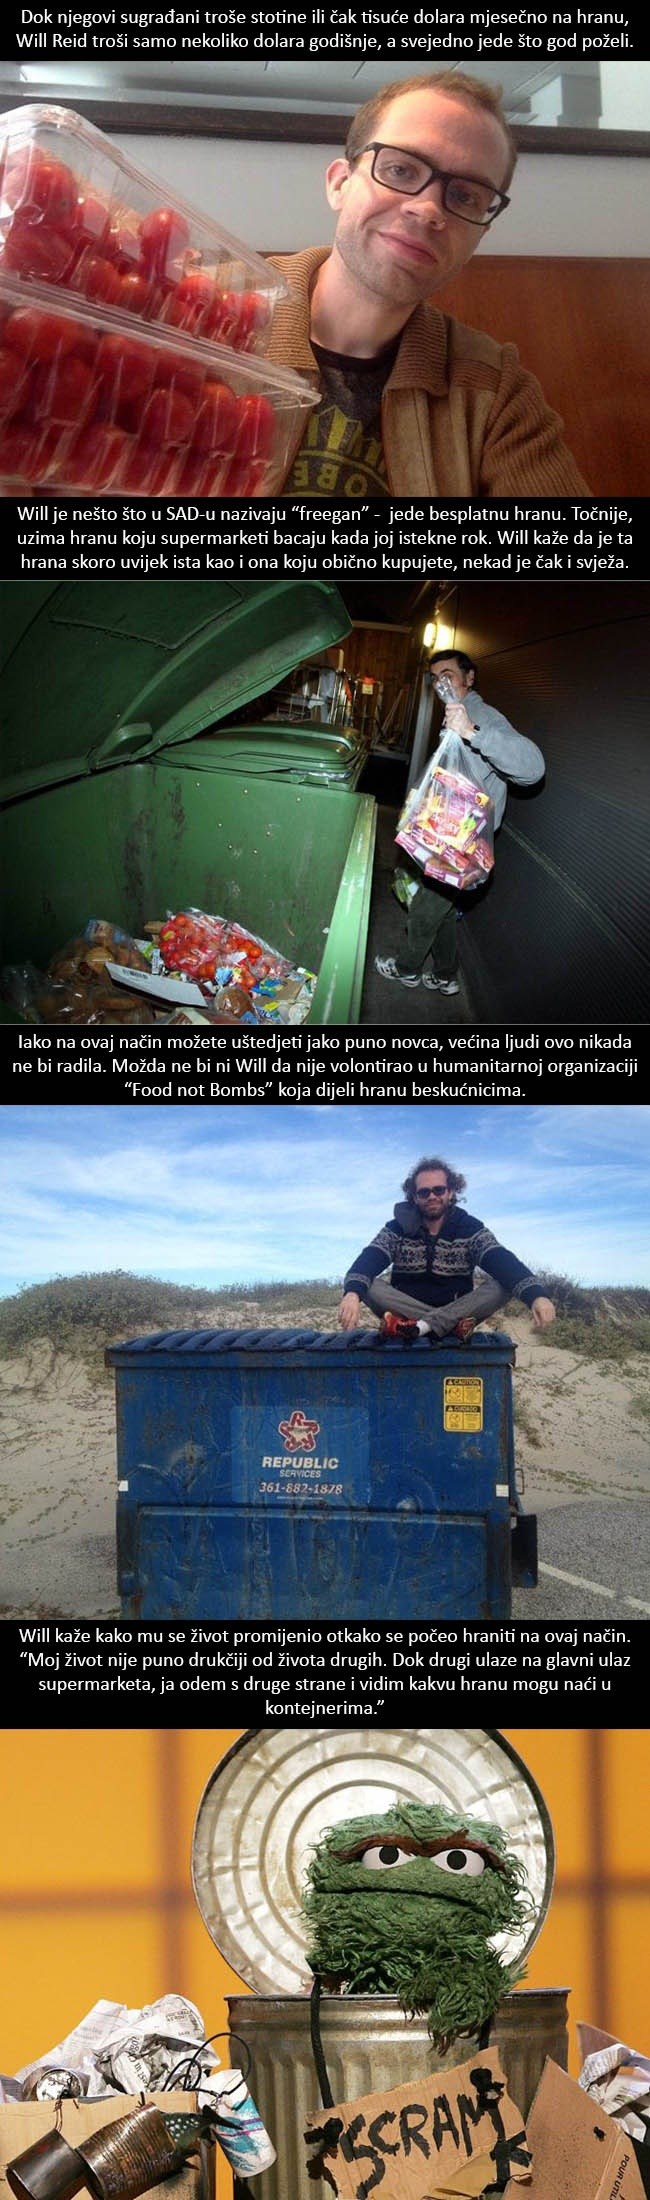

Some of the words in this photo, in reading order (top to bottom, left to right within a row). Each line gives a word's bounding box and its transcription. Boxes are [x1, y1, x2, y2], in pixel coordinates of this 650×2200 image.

[261, 1456, 340, 1470] REPUBLIC
[279, 1469, 321, 1479] SERVICES
[259, 1482, 343, 1495] 361-882-1878
[339, 2092, 506, 2200] SCRAM
[615, 2153, 630, 2180] POUR
